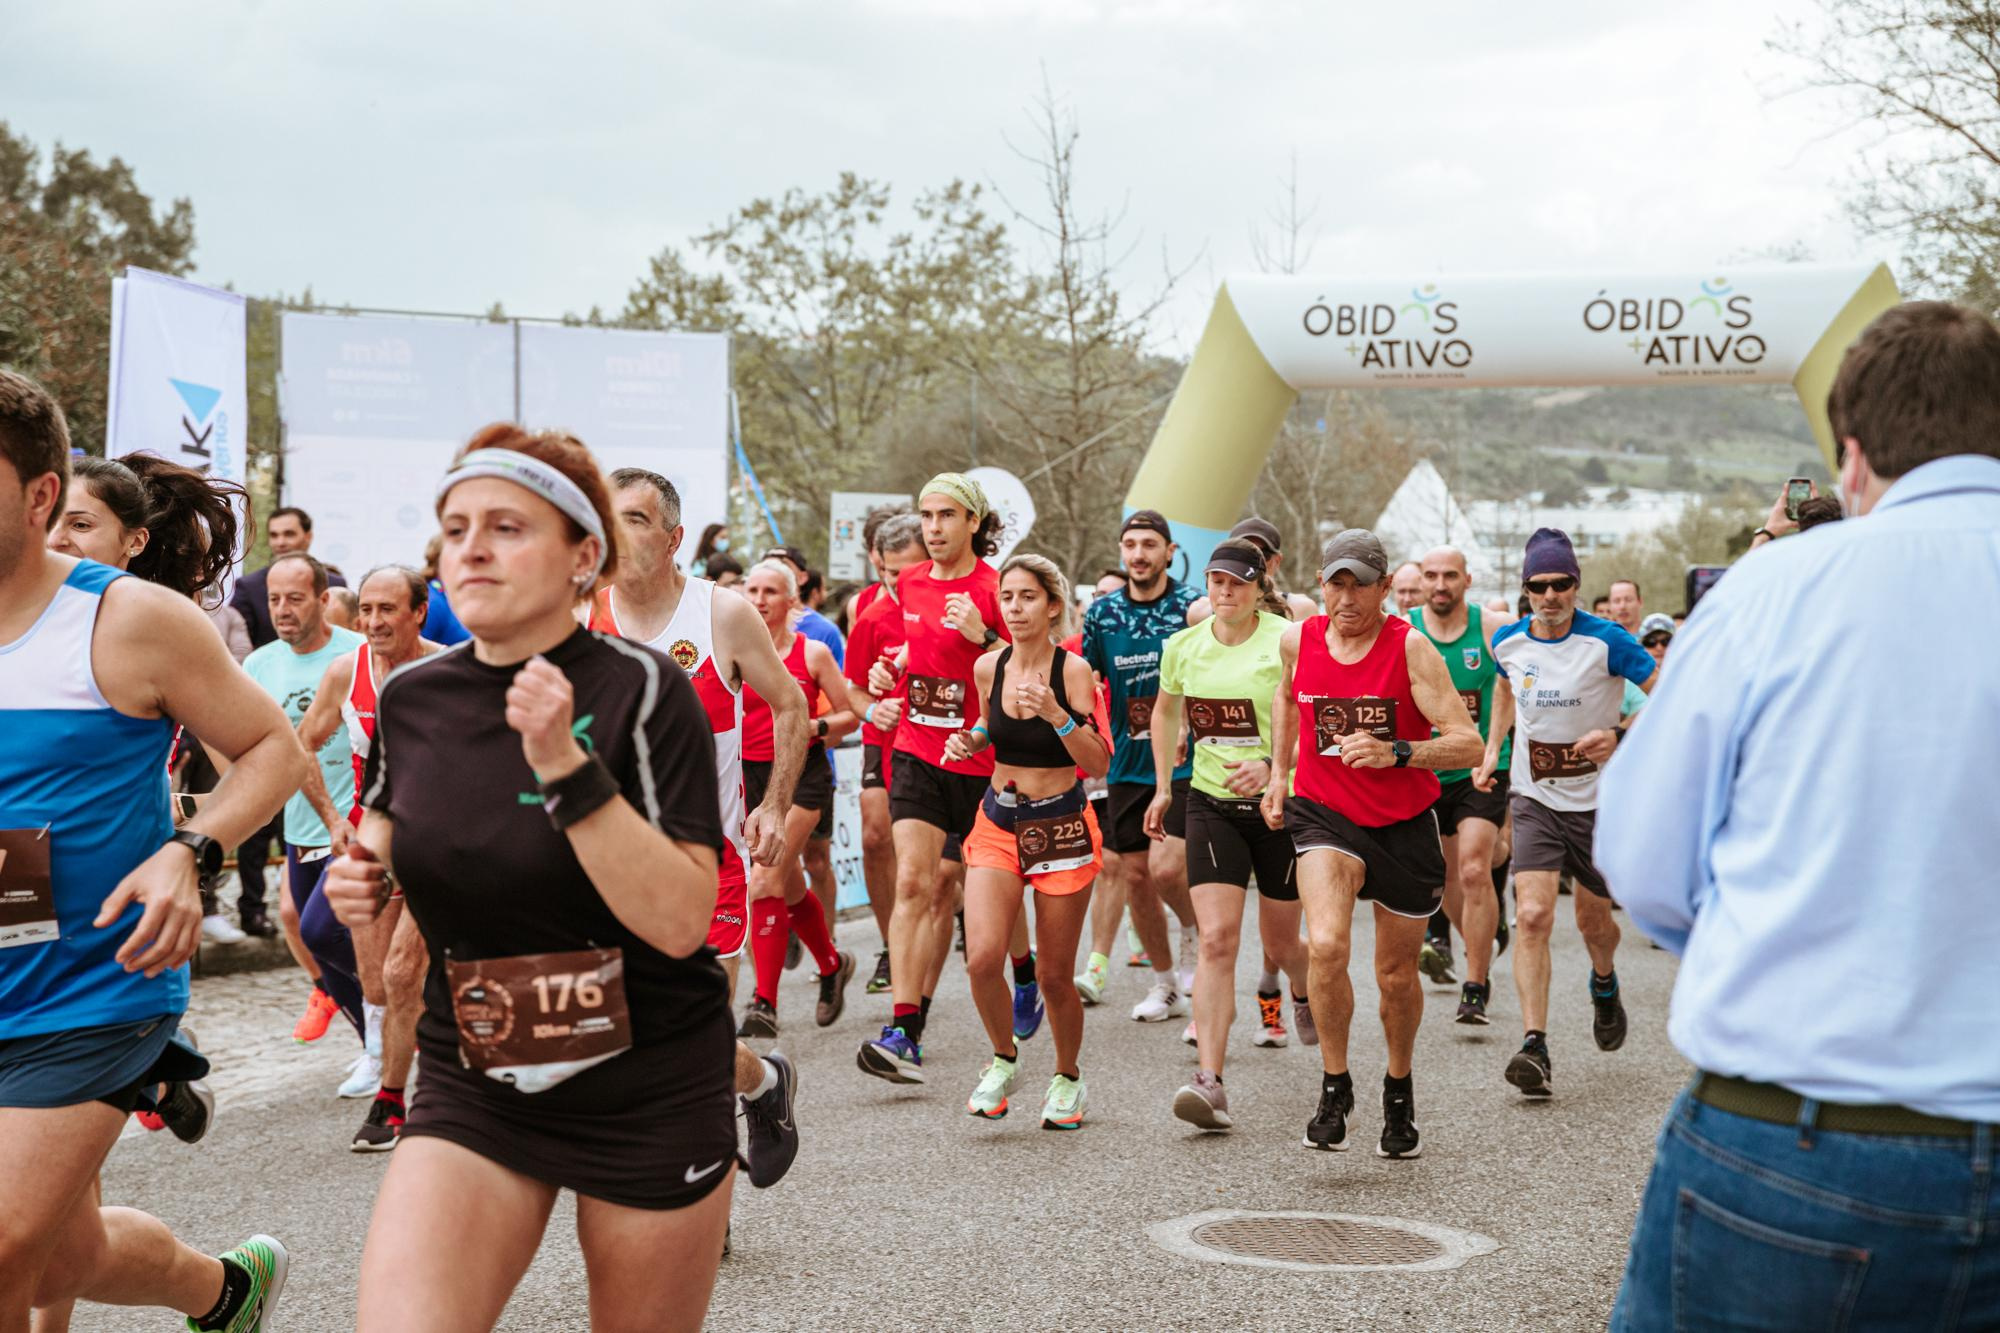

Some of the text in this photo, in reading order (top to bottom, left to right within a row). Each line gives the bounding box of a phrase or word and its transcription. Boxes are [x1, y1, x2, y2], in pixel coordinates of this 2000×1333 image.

[1114, 651, 1159, 666] Electrofil
[935, 685, 954, 700] 46
[1537, 689, 1561, 698] BEER
[1536, 697, 1582, 708] RUNNERS
[1221, 705, 1246, 719] 141
[1355, 706, 1387, 723] 125
[1053, 820, 1085, 840] 229
[531, 971, 604, 1013] 176
